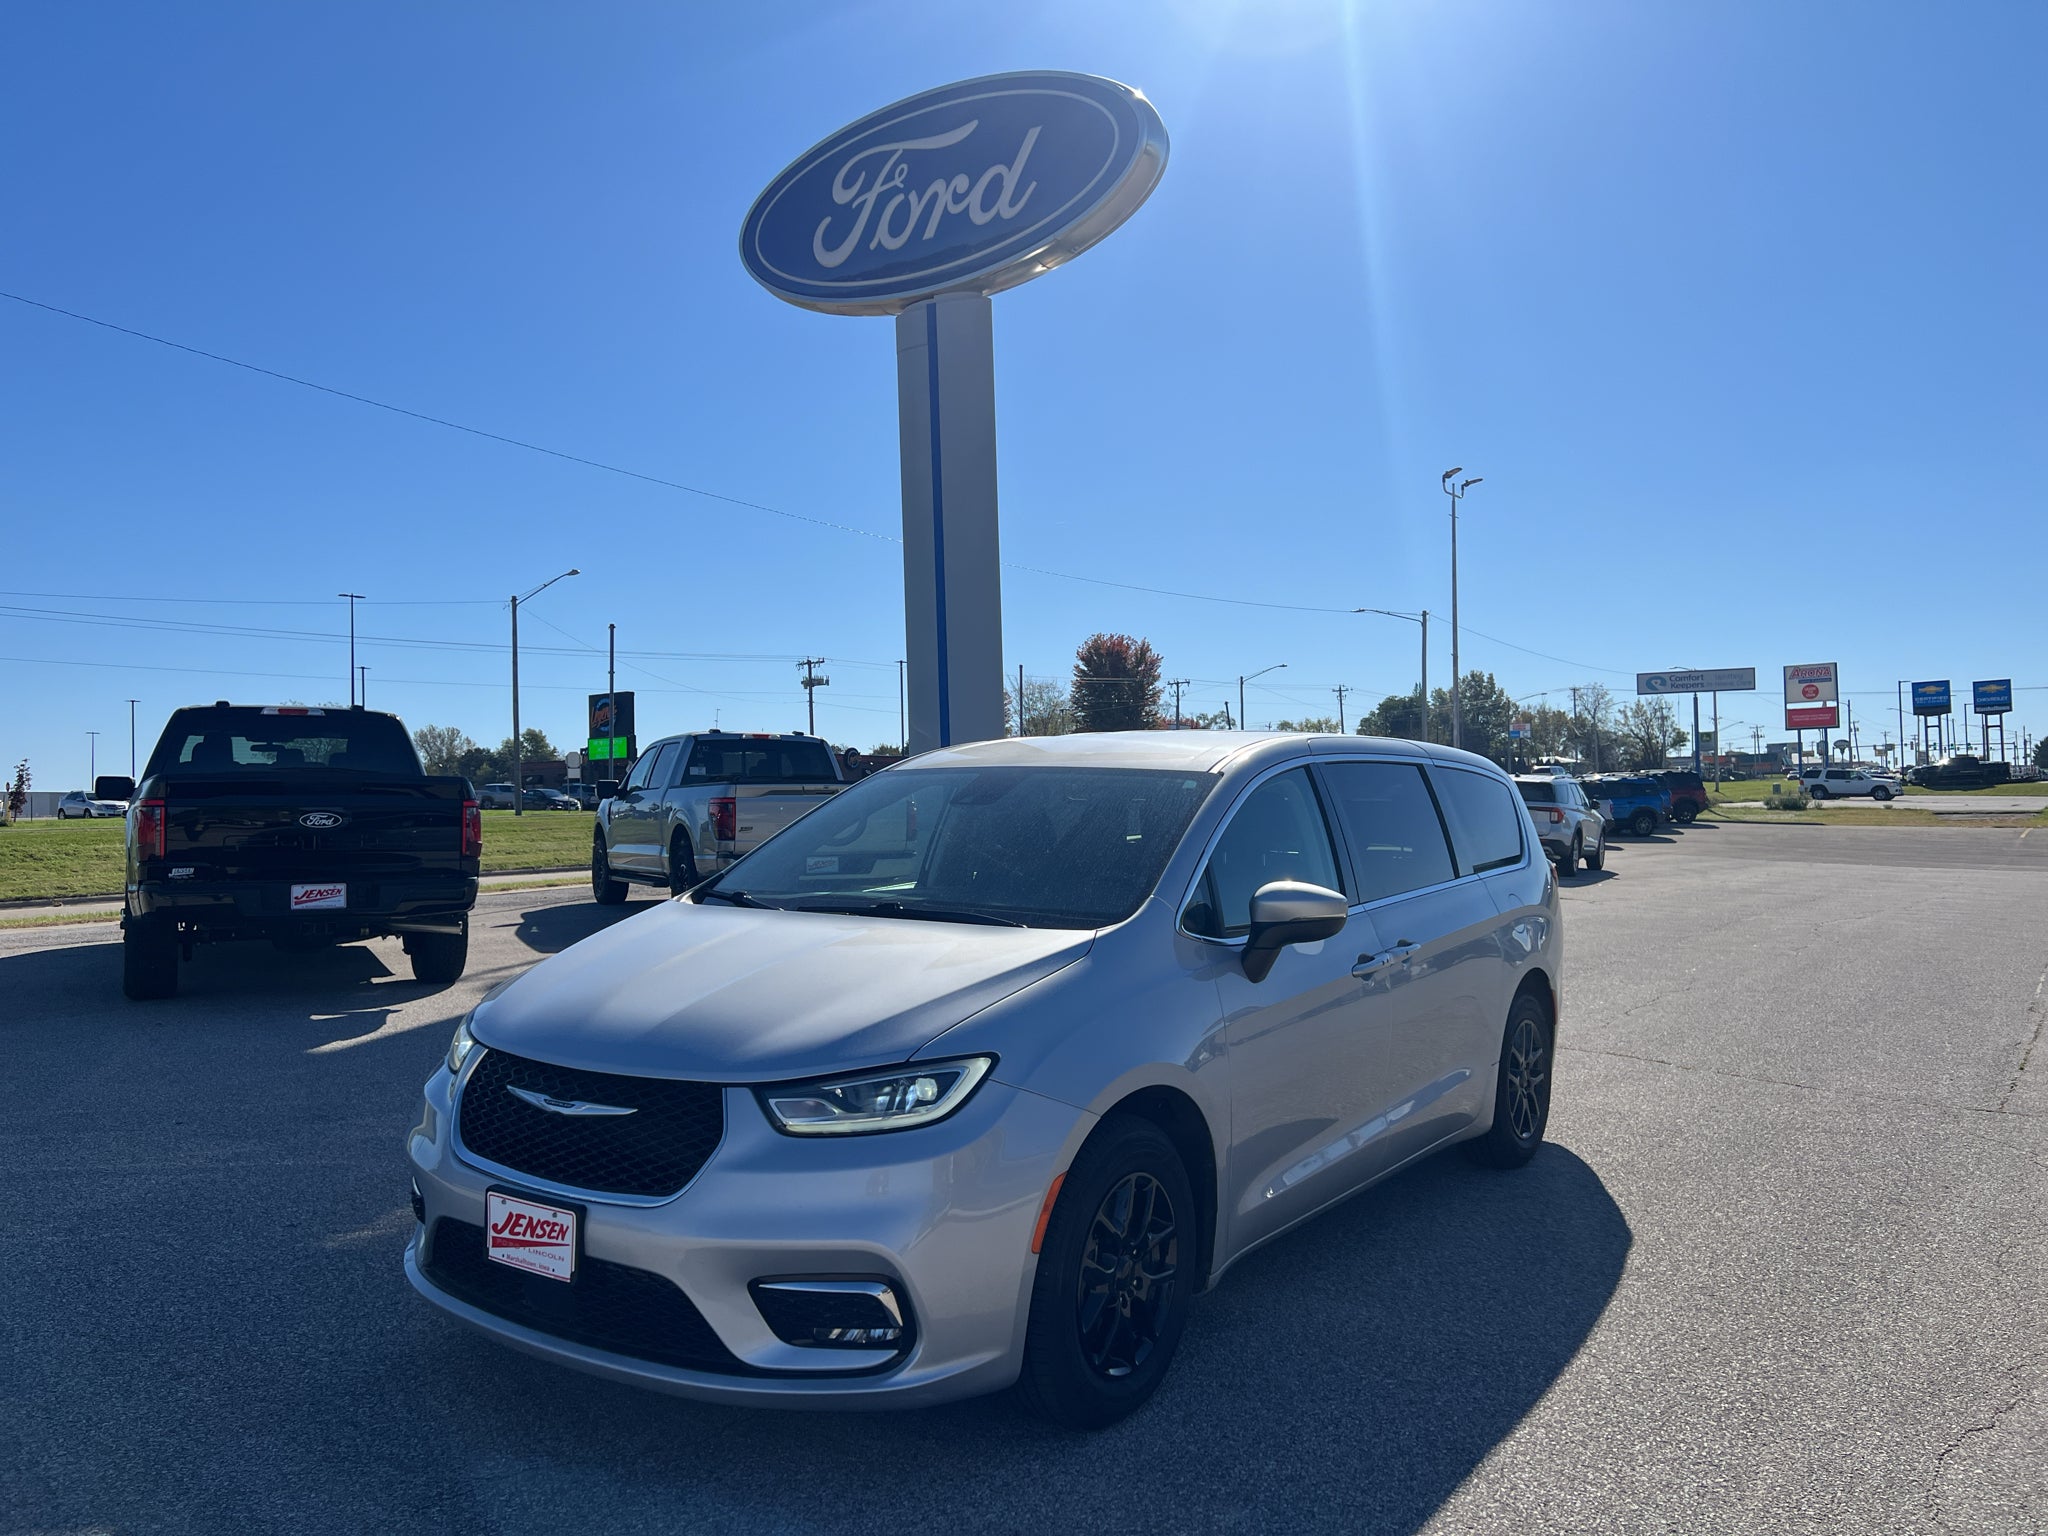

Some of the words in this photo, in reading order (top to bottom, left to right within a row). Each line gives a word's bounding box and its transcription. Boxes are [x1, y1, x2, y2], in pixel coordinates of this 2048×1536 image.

[813, 119, 1042, 268] Ford
[1669, 674, 1704, 683] Comfort
[1789, 666, 1832, 680] ARONA
[1670, 682, 1705, 690] Keepers
[306, 814, 335, 826] Ford
[294, 888, 343, 901] JENSEN
[491, 1211, 570, 1242] JENSEN
[528, 1248, 565, 1262] LINCOLN
